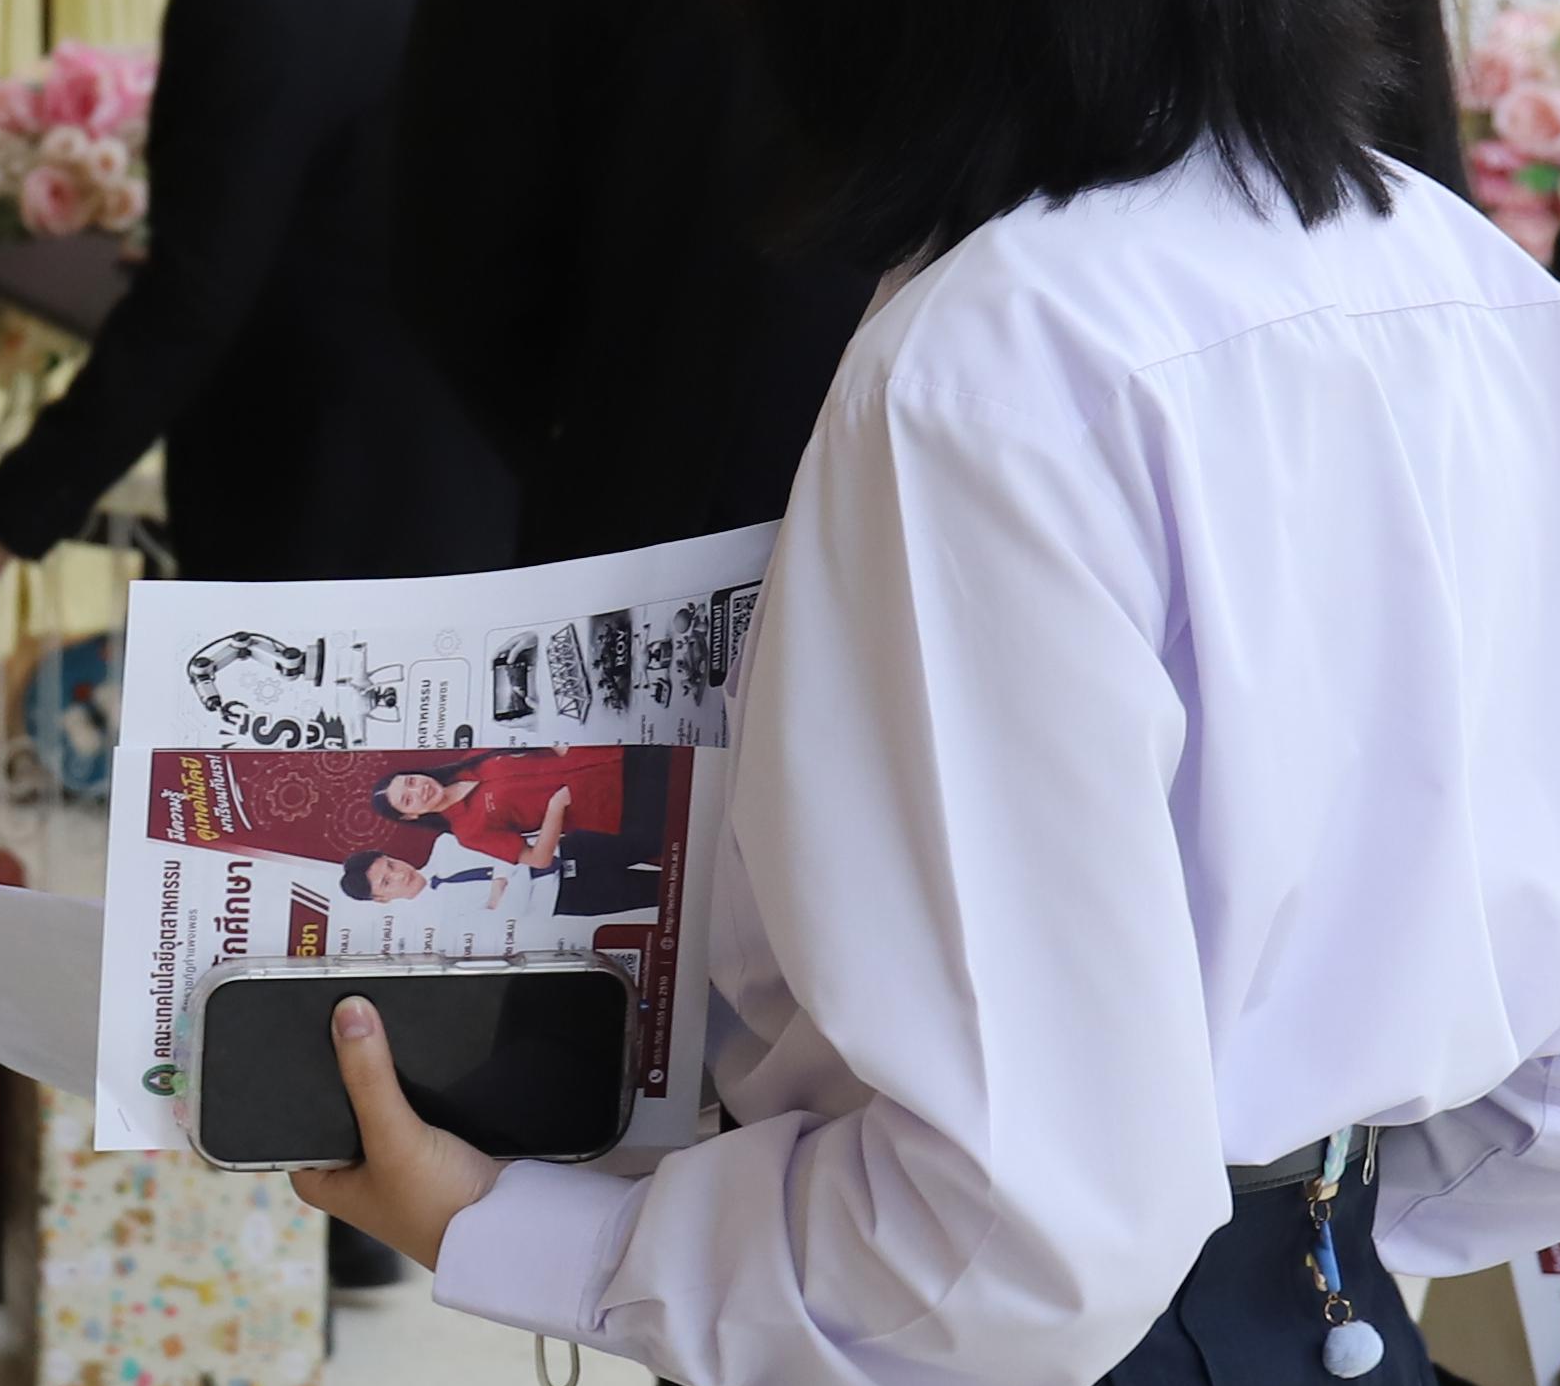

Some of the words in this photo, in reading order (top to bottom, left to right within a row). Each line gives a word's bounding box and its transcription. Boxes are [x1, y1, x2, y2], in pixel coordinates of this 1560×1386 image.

[150, 860, 184, 1058] คณะเทคโนโลยีอุตสาหกรรม
[212, 861, 253, 966] ักศึกษา
[296, 923, 319, 957] วิชา
